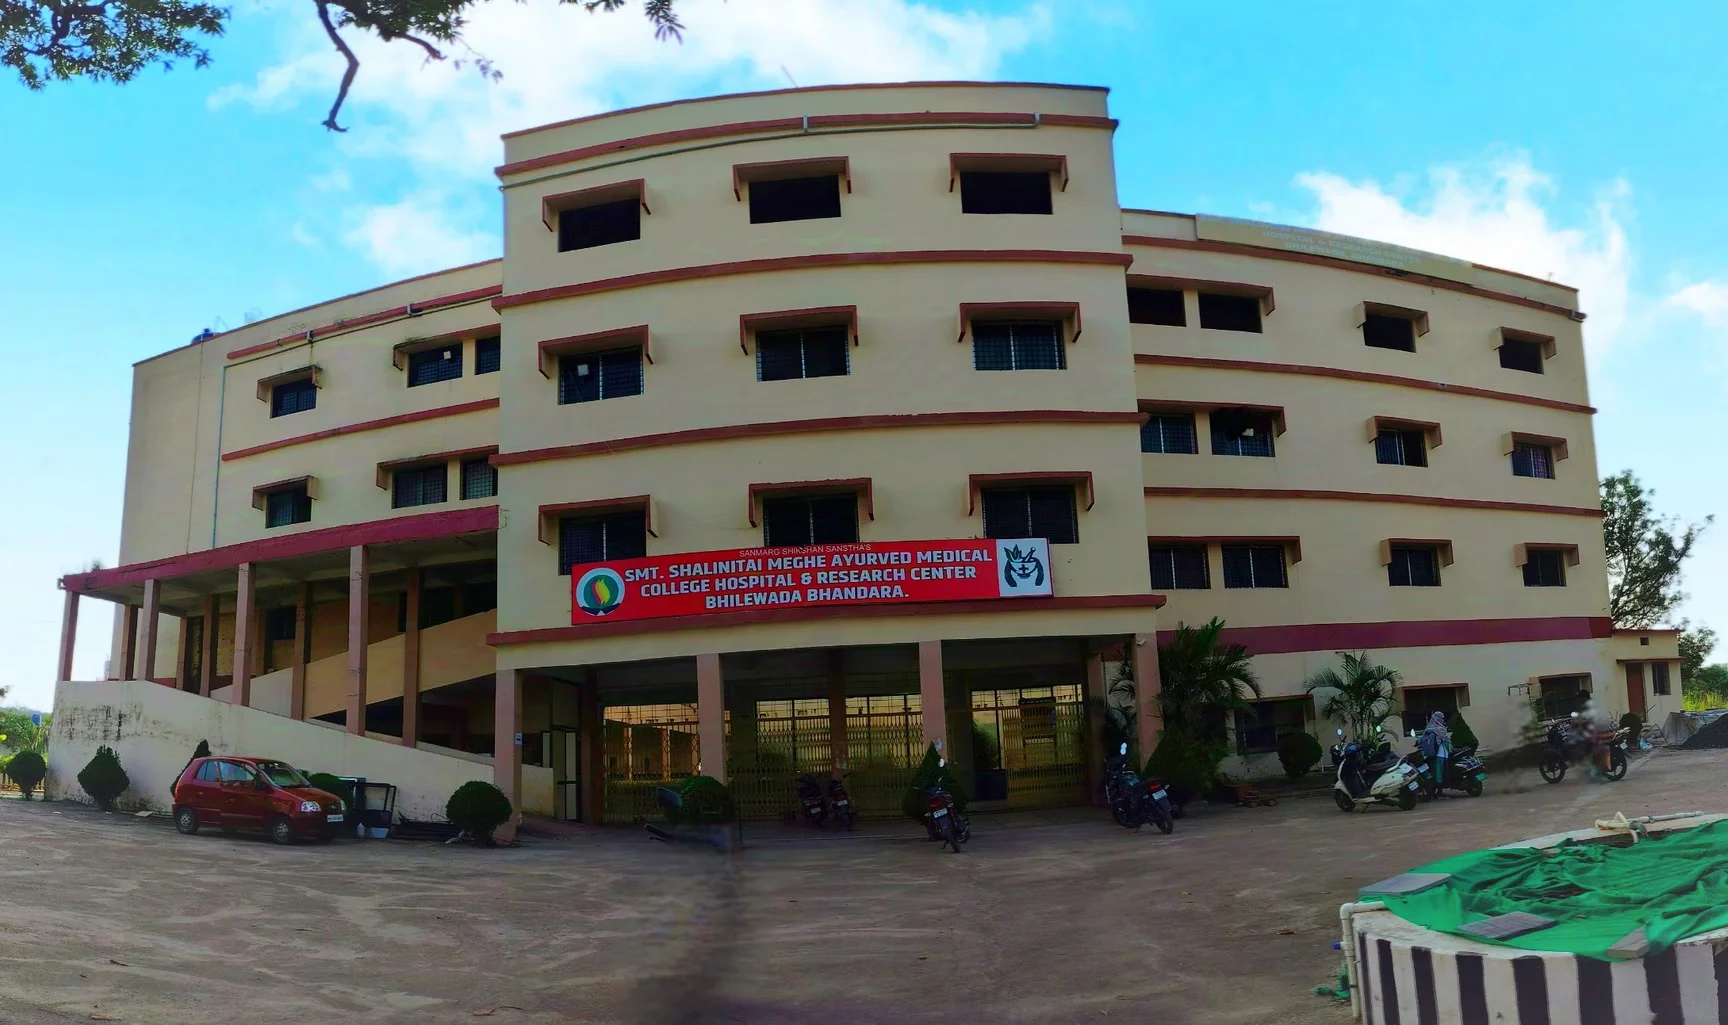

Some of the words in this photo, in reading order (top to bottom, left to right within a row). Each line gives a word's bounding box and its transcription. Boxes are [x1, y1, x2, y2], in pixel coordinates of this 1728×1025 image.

[739, 548, 780, 557] SANMARG
[782, 546, 824, 555] SHIKSHAN
[825, 543, 872, 553] SANSTHA'S
[624, 566, 665, 582] SMT.
[668, 558, 763, 577] SHALINITAI
[767, 554, 827, 571] MEGHE
[831, 550, 912, 567] AYURVED
[917, 548, 993, 564] MEDICAL
[640, 579, 710, 597] COLLEGE
[715, 573, 797, 592] HOSPITAL
[801, 573, 813, 585] &
[816, 567, 906, 585] RESEARCH
[910, 565, 977, 581] CENTER
[705, 588, 803, 609] BHILEWADA
[807, 584, 910, 602] BHANDARA.
